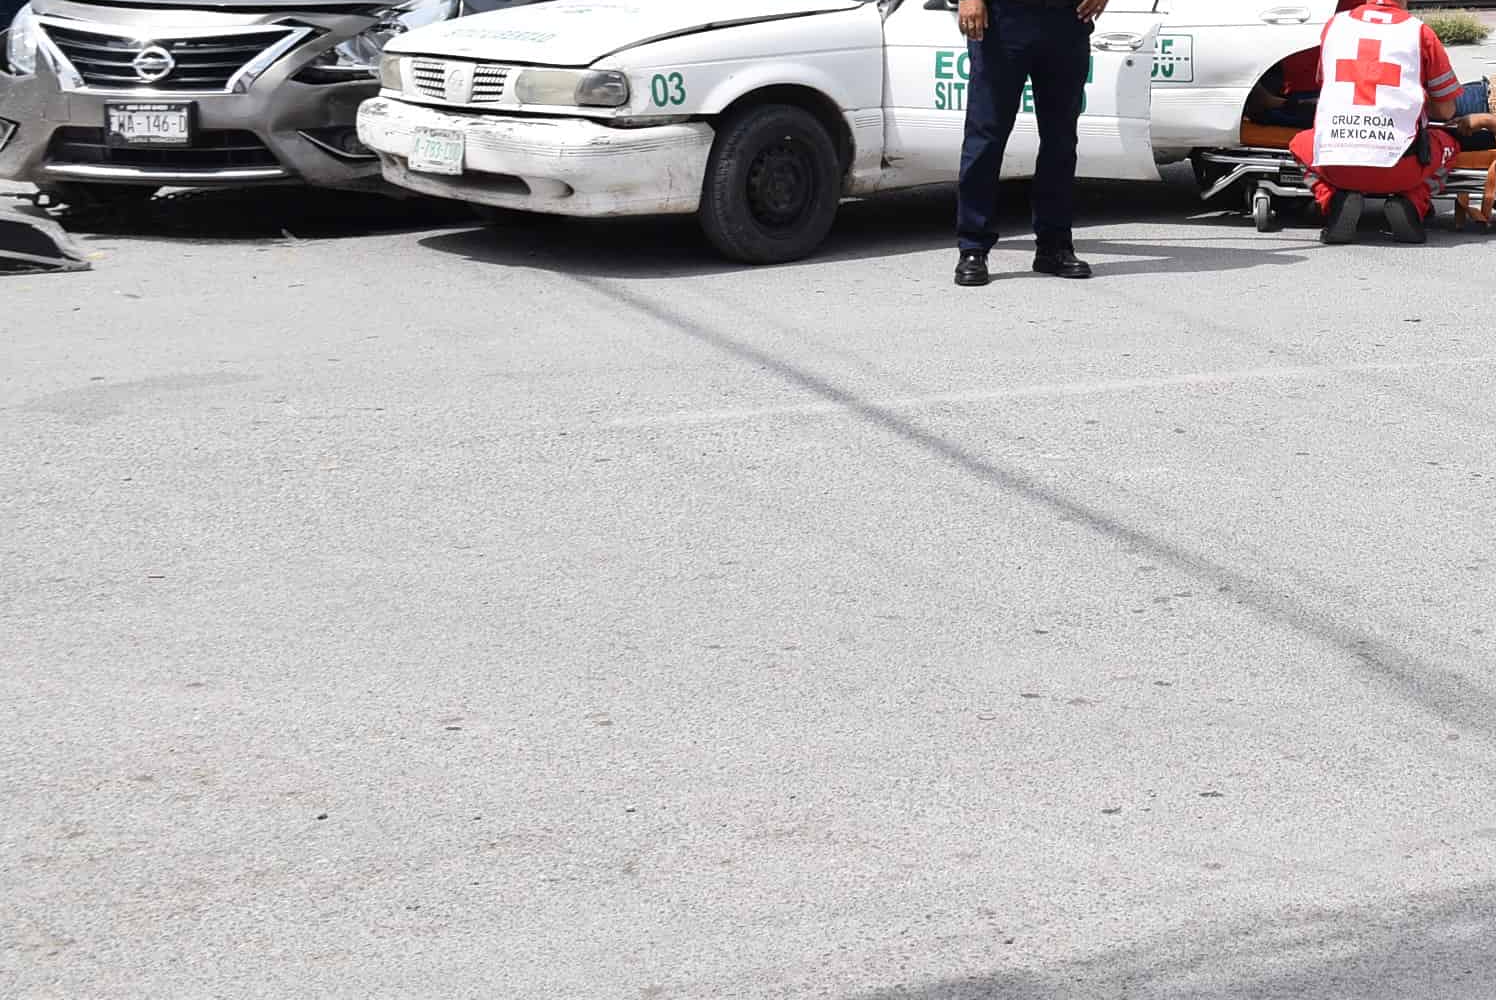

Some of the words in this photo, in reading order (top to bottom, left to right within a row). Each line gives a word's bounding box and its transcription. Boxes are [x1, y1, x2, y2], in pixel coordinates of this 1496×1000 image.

[651, 71, 687, 107] 03
[1331, 114, 1361, 126] CRUZ
[1363, 115, 1395, 128] ROJA
[1330, 128, 1396, 141] MEXICANA
